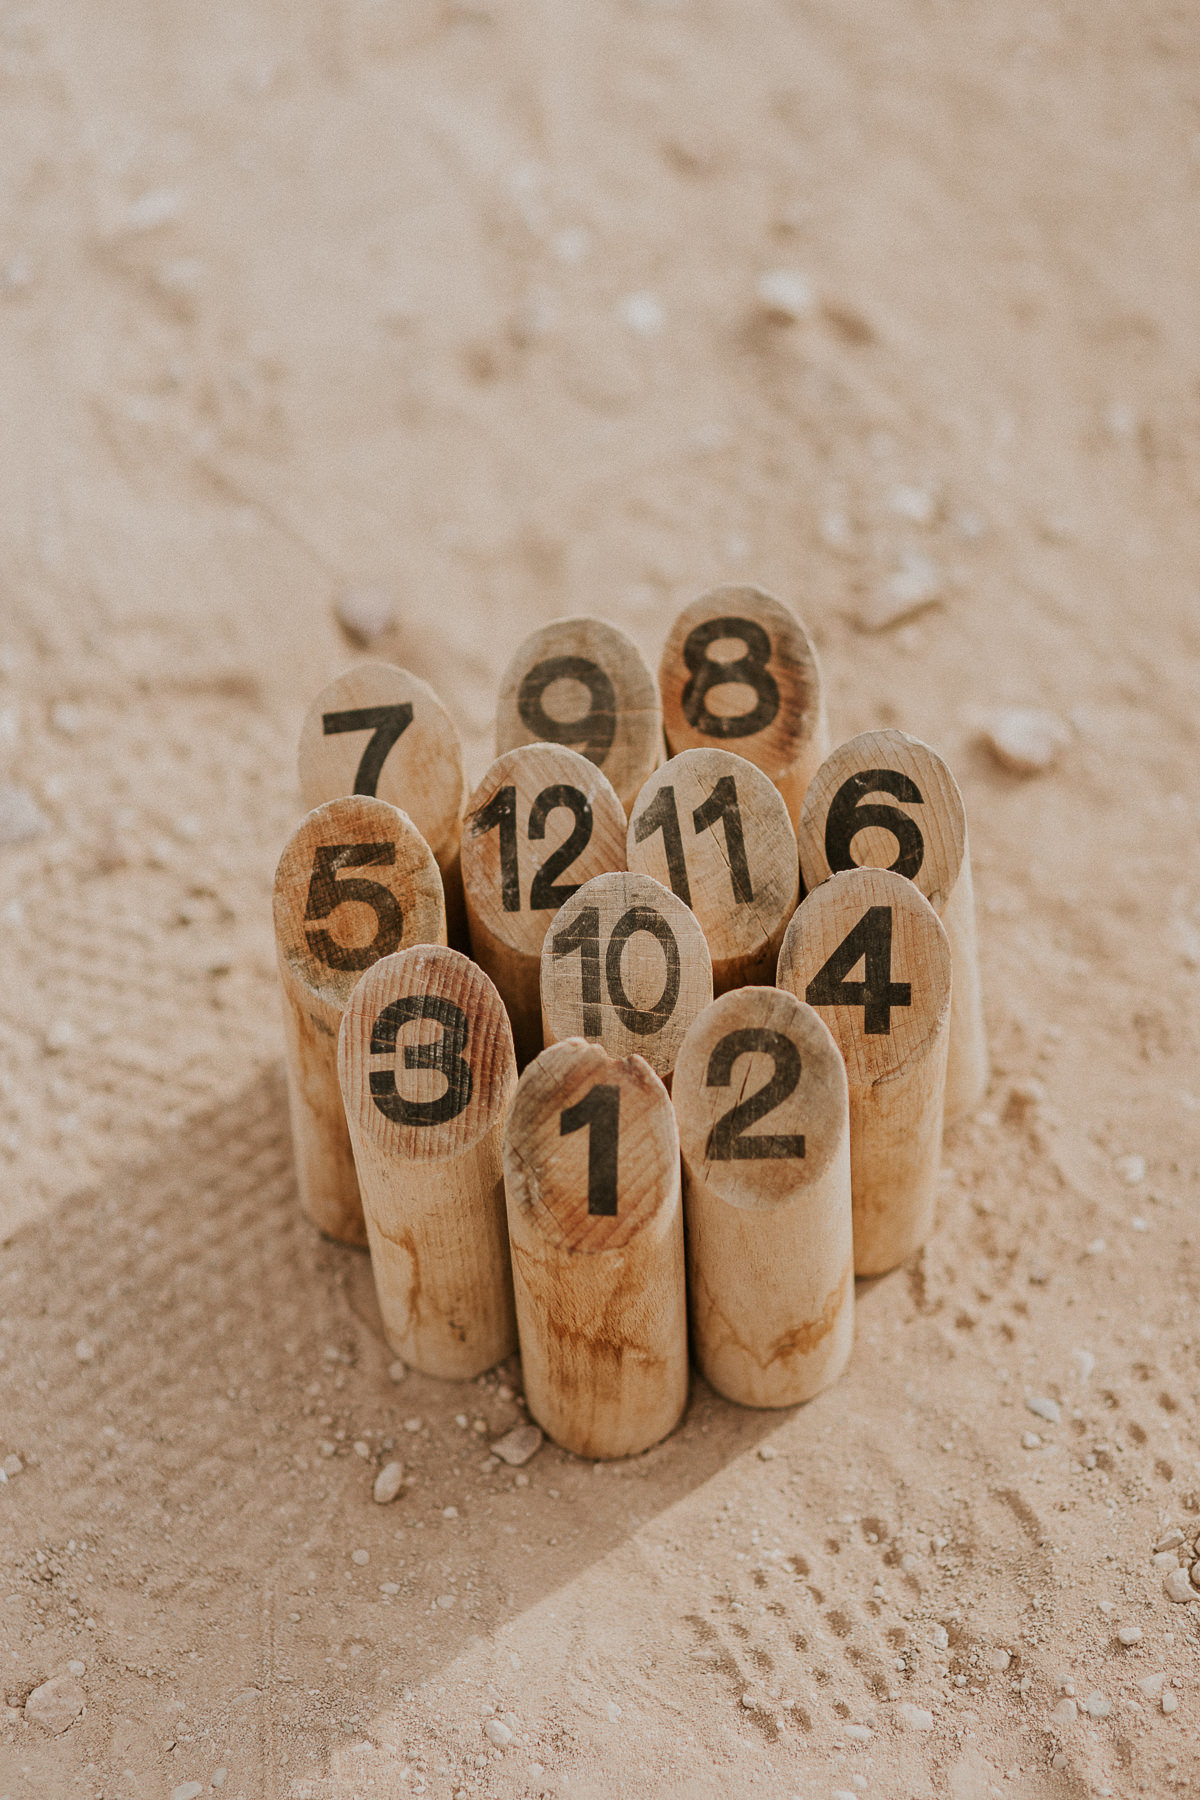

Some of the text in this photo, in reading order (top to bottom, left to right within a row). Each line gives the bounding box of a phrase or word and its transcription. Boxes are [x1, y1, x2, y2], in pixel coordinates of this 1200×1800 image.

[517, 655, 617, 768] 9
[681, 616, 780, 738] 8
[322, 701, 413, 798] 7
[463, 784, 596, 912] 12
[635, 776, 754, 909] 11
[824, 768, 925, 880] 6
[304, 840, 404, 972] 5
[552, 905, 681, 1037] 10
[805, 906, 912, 1036] 4
[368, 994, 473, 1127] 3
[704, 1028, 806, 1161] 2
[559, 1084, 621, 1217] 1
